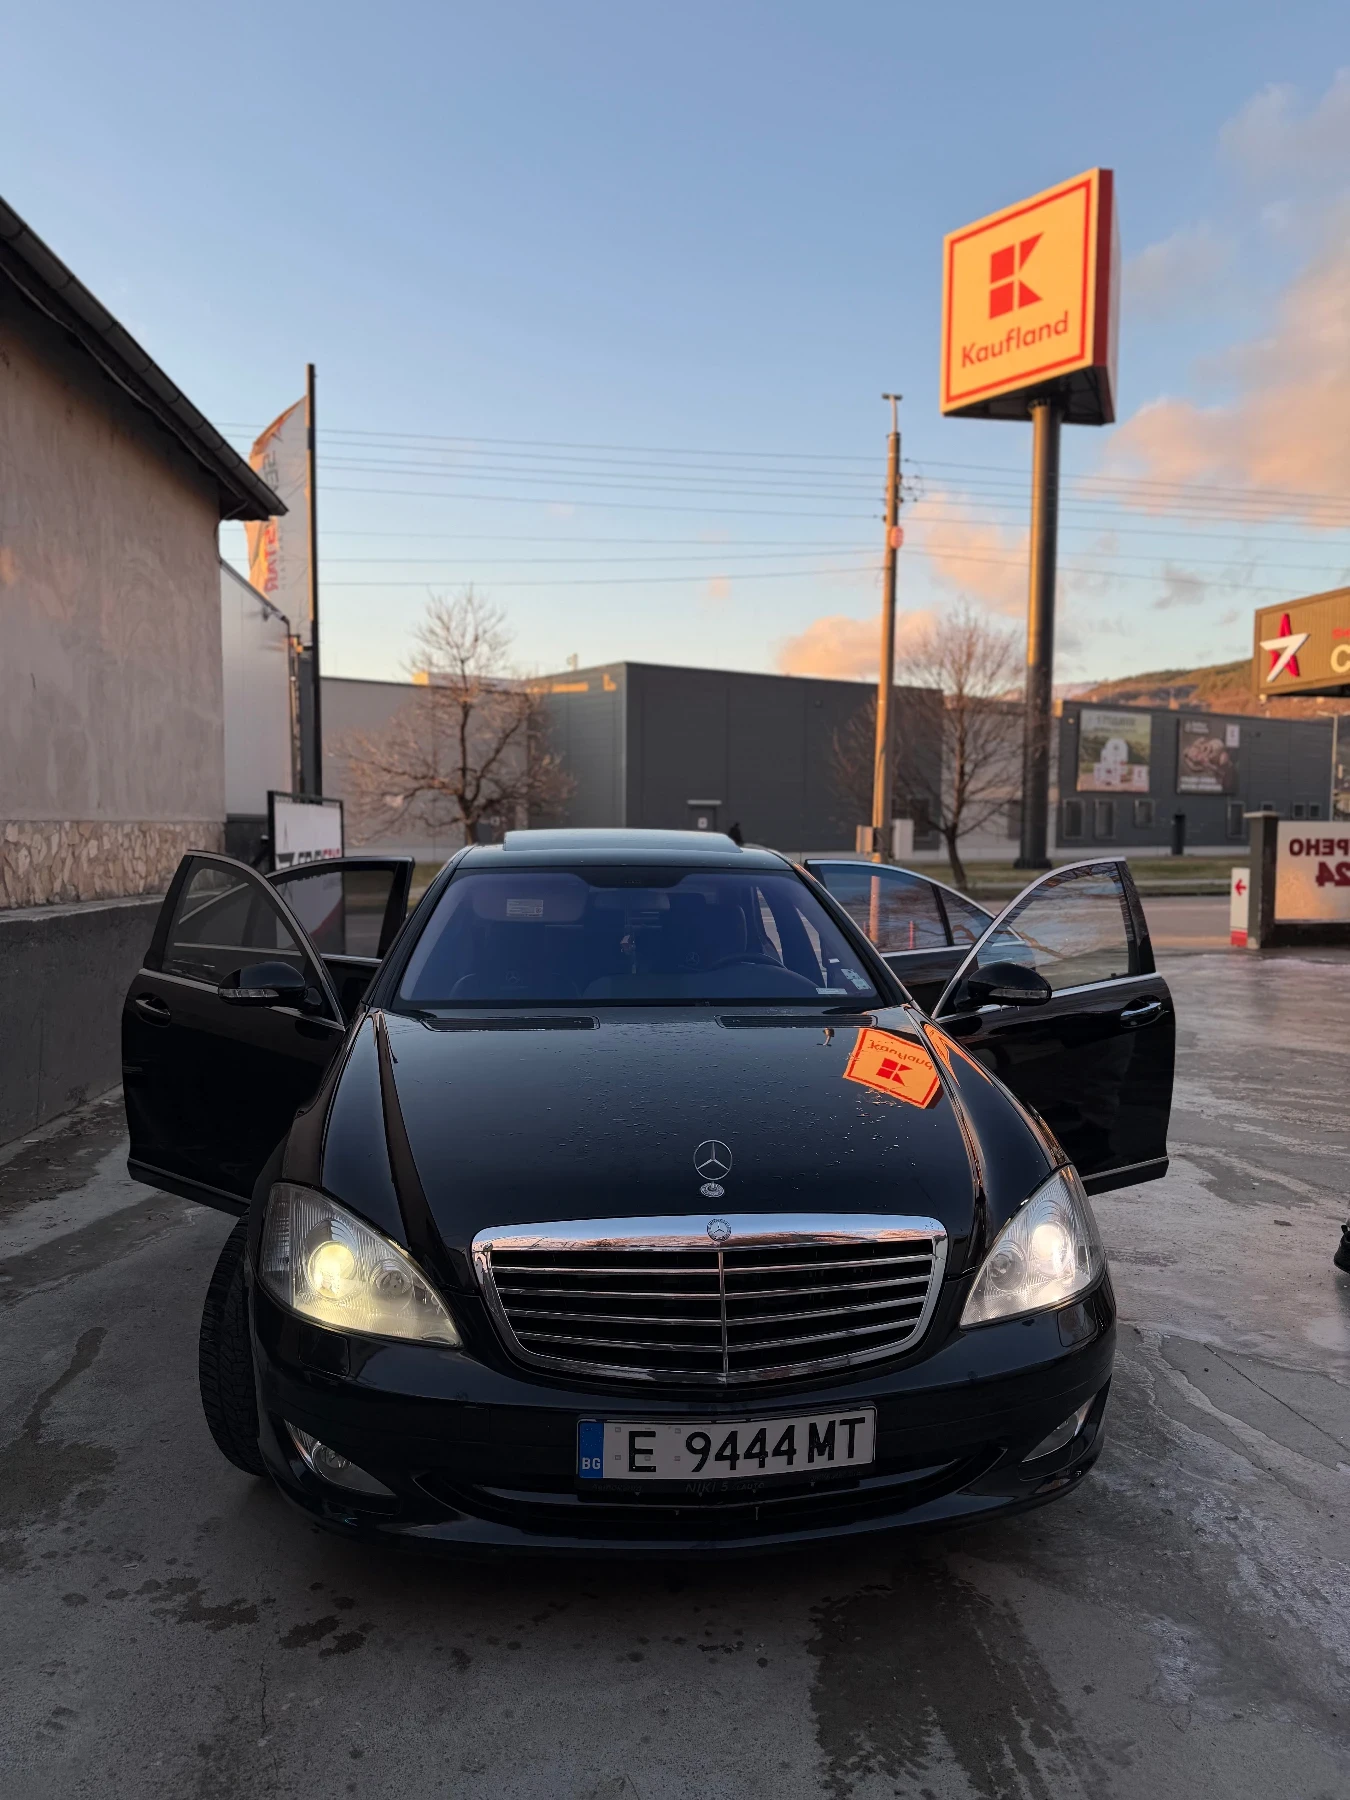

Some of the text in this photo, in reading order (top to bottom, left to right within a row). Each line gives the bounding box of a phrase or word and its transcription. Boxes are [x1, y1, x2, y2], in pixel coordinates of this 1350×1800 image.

[961, 310, 1069, 368] Kaufland
[581, 1457, 601, 1470] BG
[628, 1430, 656, 1472] E
